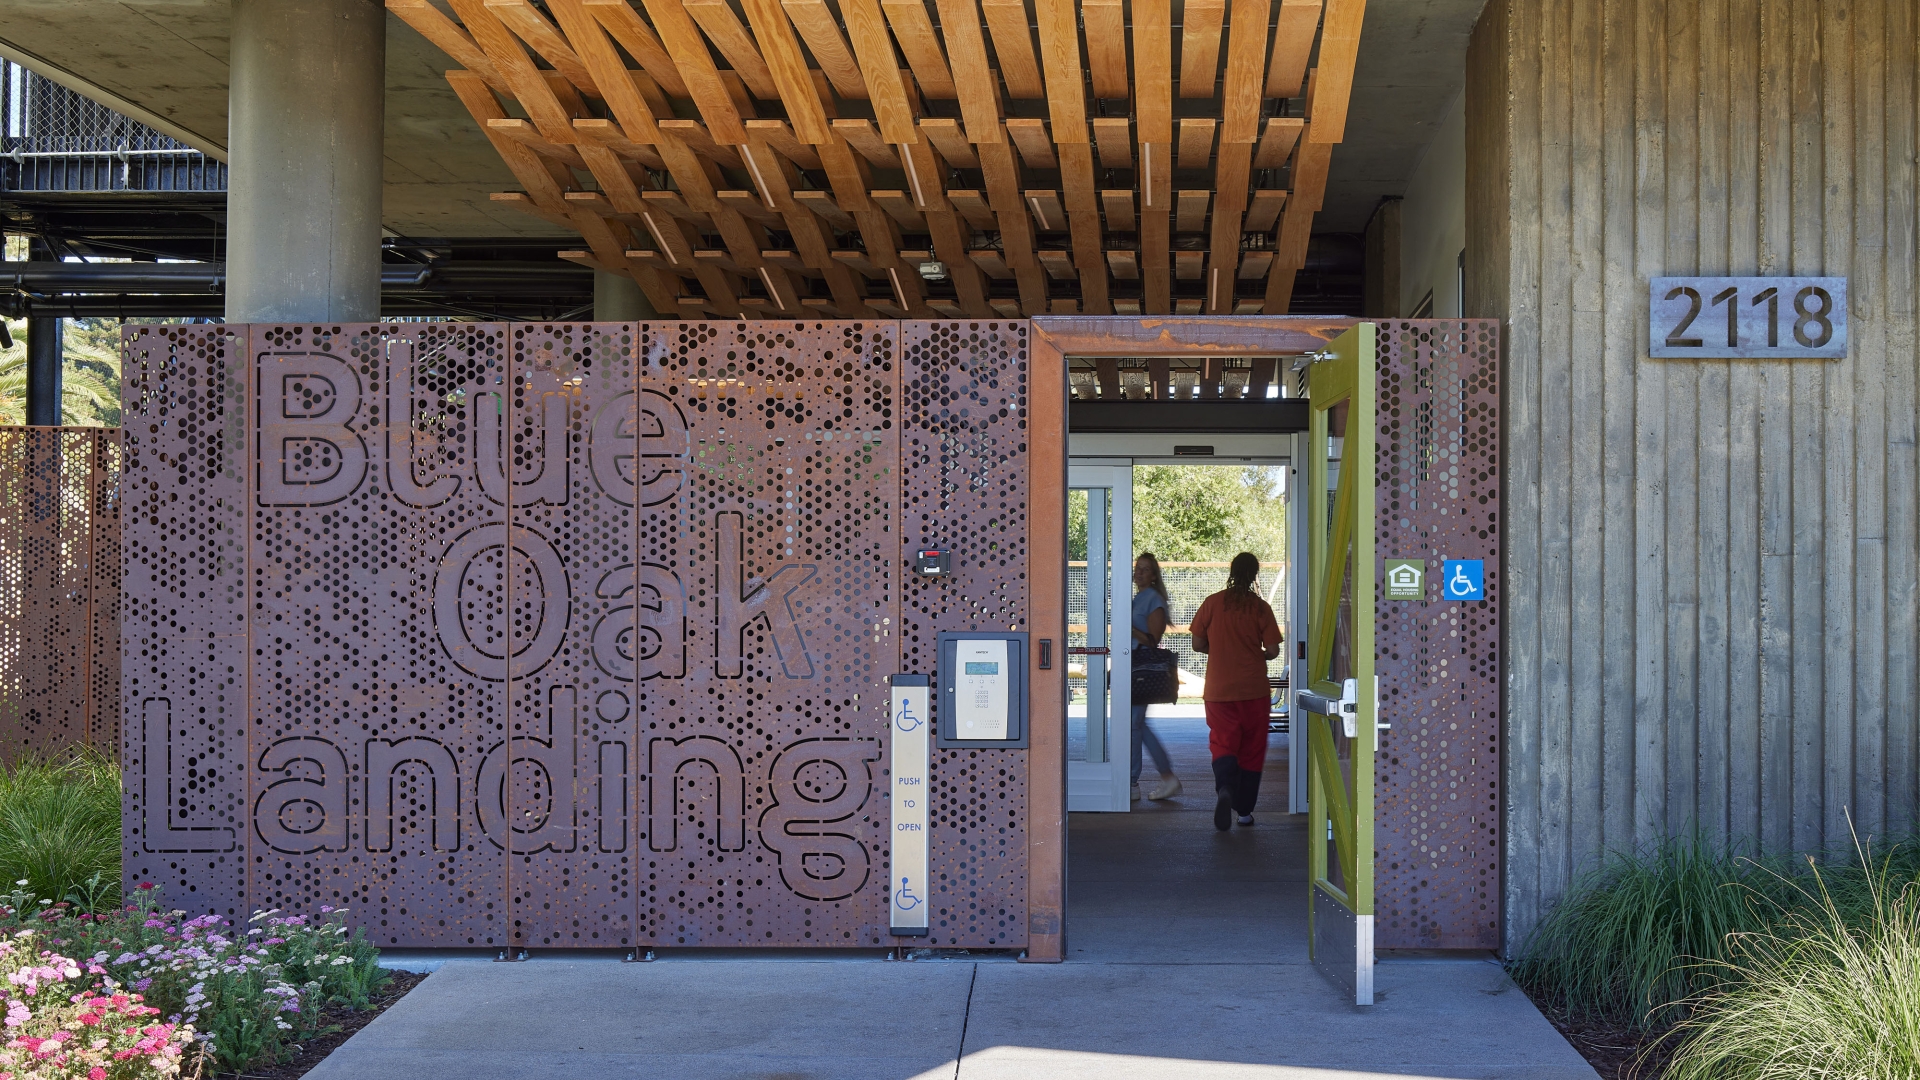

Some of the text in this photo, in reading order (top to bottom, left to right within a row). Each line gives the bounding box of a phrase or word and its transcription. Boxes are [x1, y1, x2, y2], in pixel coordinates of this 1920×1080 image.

[1664, 286, 1833, 348] 2118
[257, 337, 692, 507] Blue
[431, 510, 818, 682] Oak
[142, 684, 882, 901] Landing
[898, 777, 920, 785] PUSH
[904, 800, 916, 808] TO
[897, 823, 922, 831] OPEN
